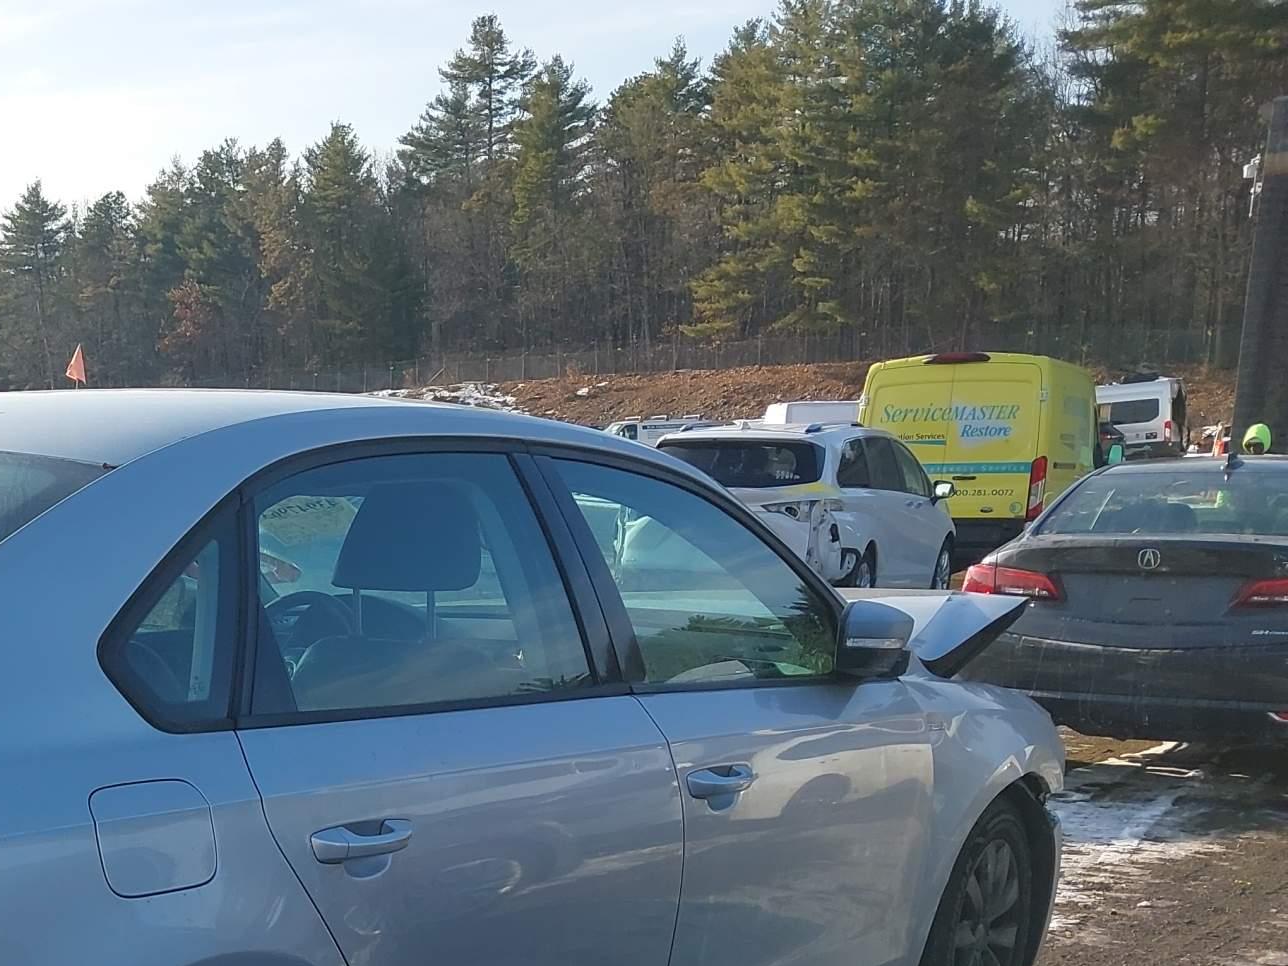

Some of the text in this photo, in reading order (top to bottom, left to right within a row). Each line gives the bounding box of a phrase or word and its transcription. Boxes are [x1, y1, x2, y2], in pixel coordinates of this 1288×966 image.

[880, 403, 1020, 423] ServiceMASTER
[915, 432, 945, 440] Services
[961, 424, 1011, 438] Restore
[952, 488, 1014, 497] 00.281.0072
